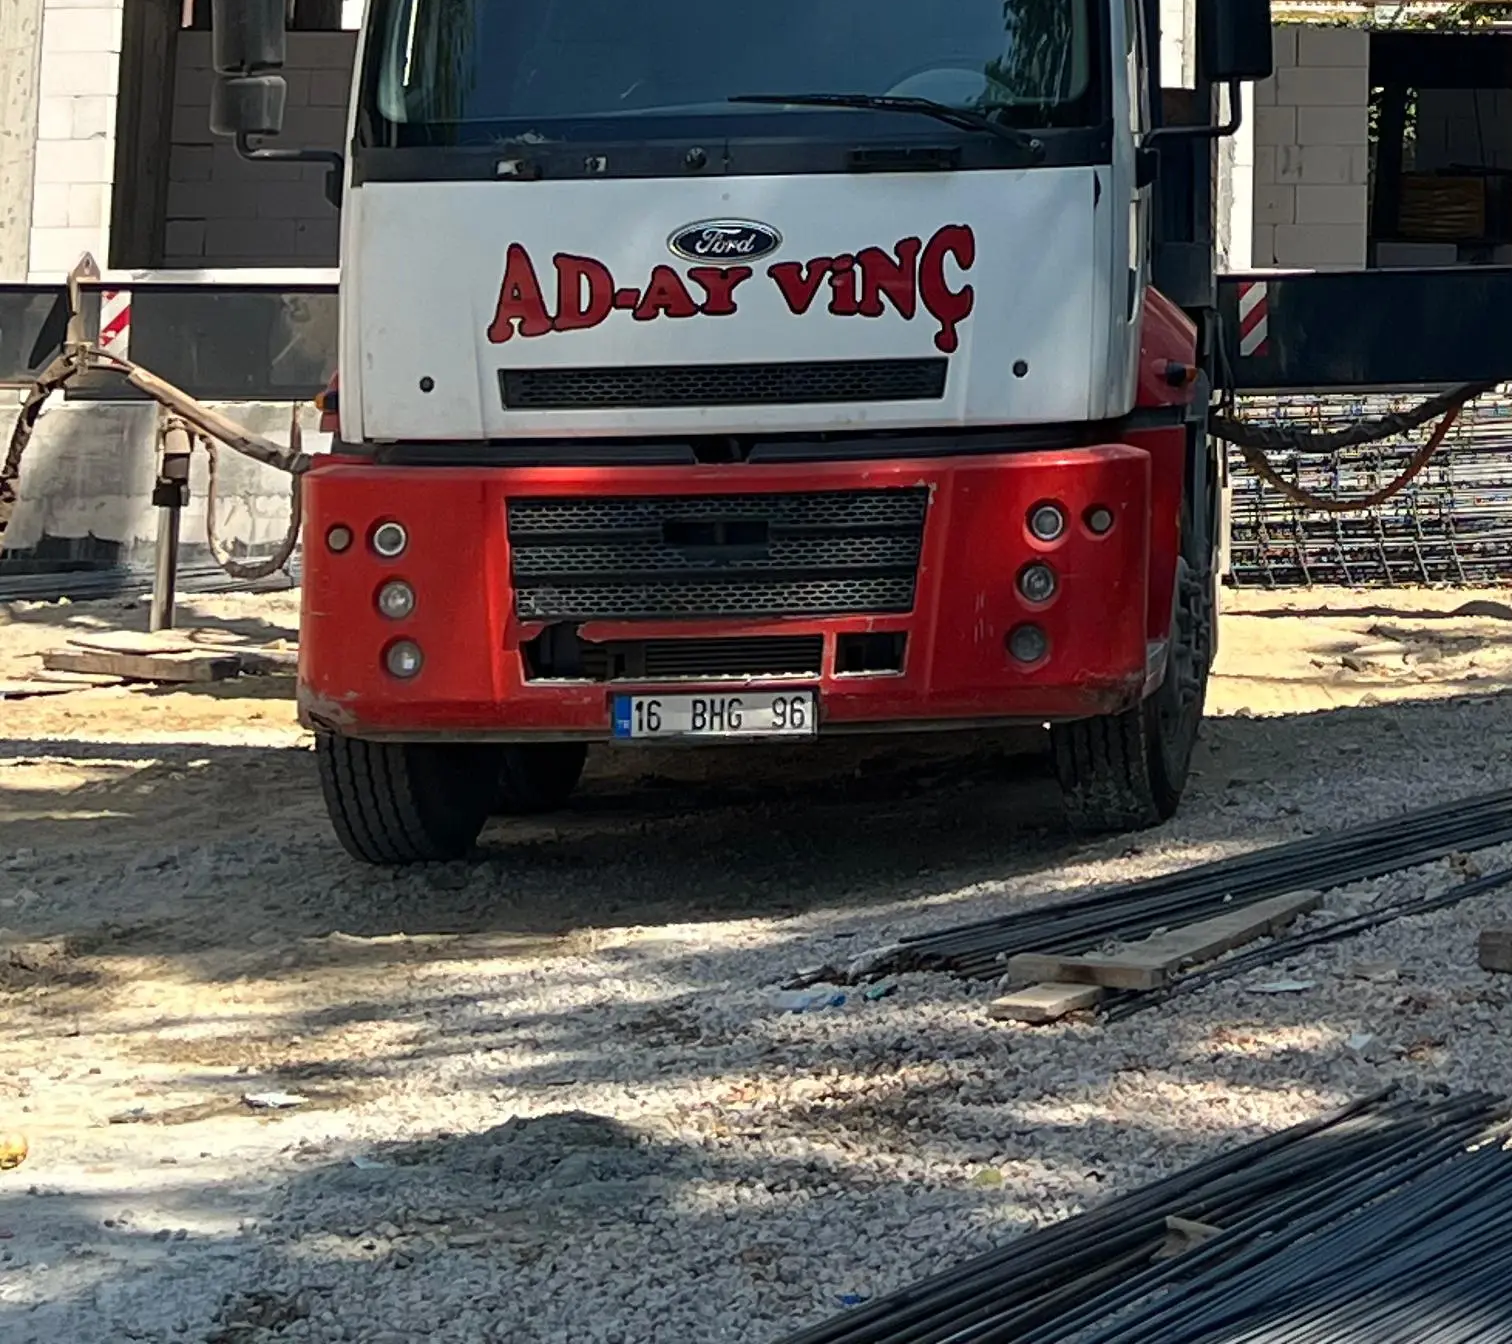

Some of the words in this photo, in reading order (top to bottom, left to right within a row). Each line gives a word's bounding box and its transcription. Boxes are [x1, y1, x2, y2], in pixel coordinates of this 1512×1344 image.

[695, 228, 757, 254] Ford
[487, 243, 754, 344] AD-AY
[635, 700, 662, 732] 16
[691, 698, 744, 731] BHG
[771, 696, 806, 729] 96
